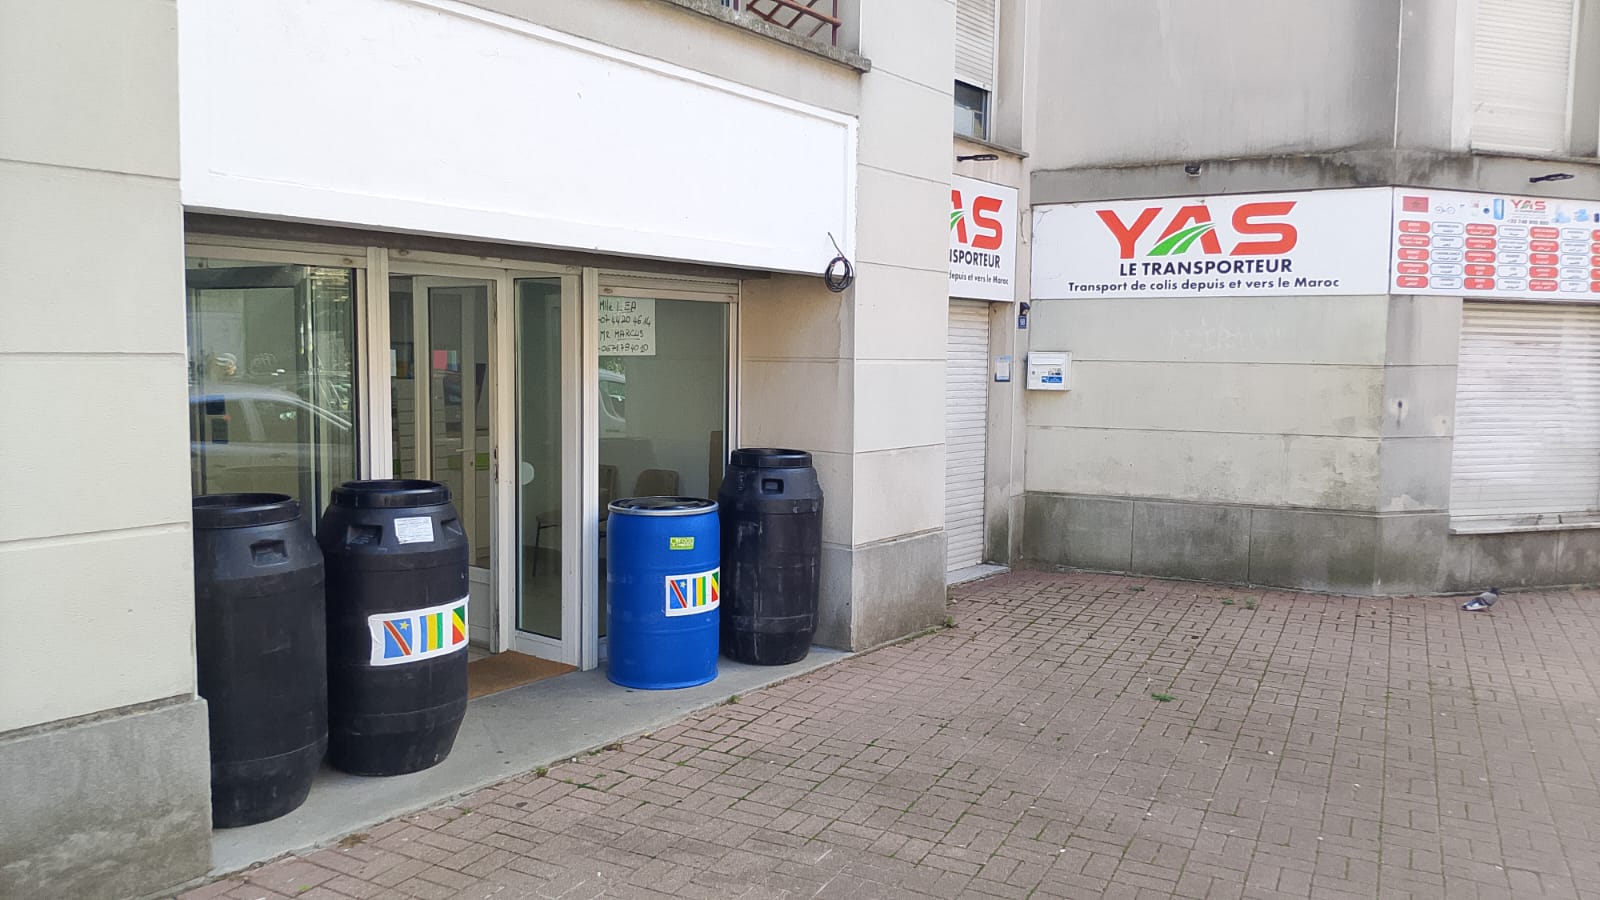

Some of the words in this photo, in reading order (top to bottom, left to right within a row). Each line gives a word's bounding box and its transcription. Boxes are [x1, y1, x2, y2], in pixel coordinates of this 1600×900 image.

[1511, 199, 1546, 211] YAS
[1096, 201, 1298, 259] YAS
[1119, 263, 1137, 277] LE
[1142, 258, 1293, 276] TRANSPORTEUR
[967, 273, 974, 281] et
[974, 275, 986, 283] vers
[986, 273, 992, 283] le
[992, 275, 1009, 285] Maroc
[1068, 281, 1128, 294] Transport
[1130, 279, 1147, 291] de
[1150, 279, 1178, 291] colis
[1181, 278, 1225, 293] depuis
[1228, 279, 1242, 289] et
[1245, 279, 1275, 289] vers
[1277, 277, 1290, 288] le
[1294, 276, 1340, 288] Maroc
